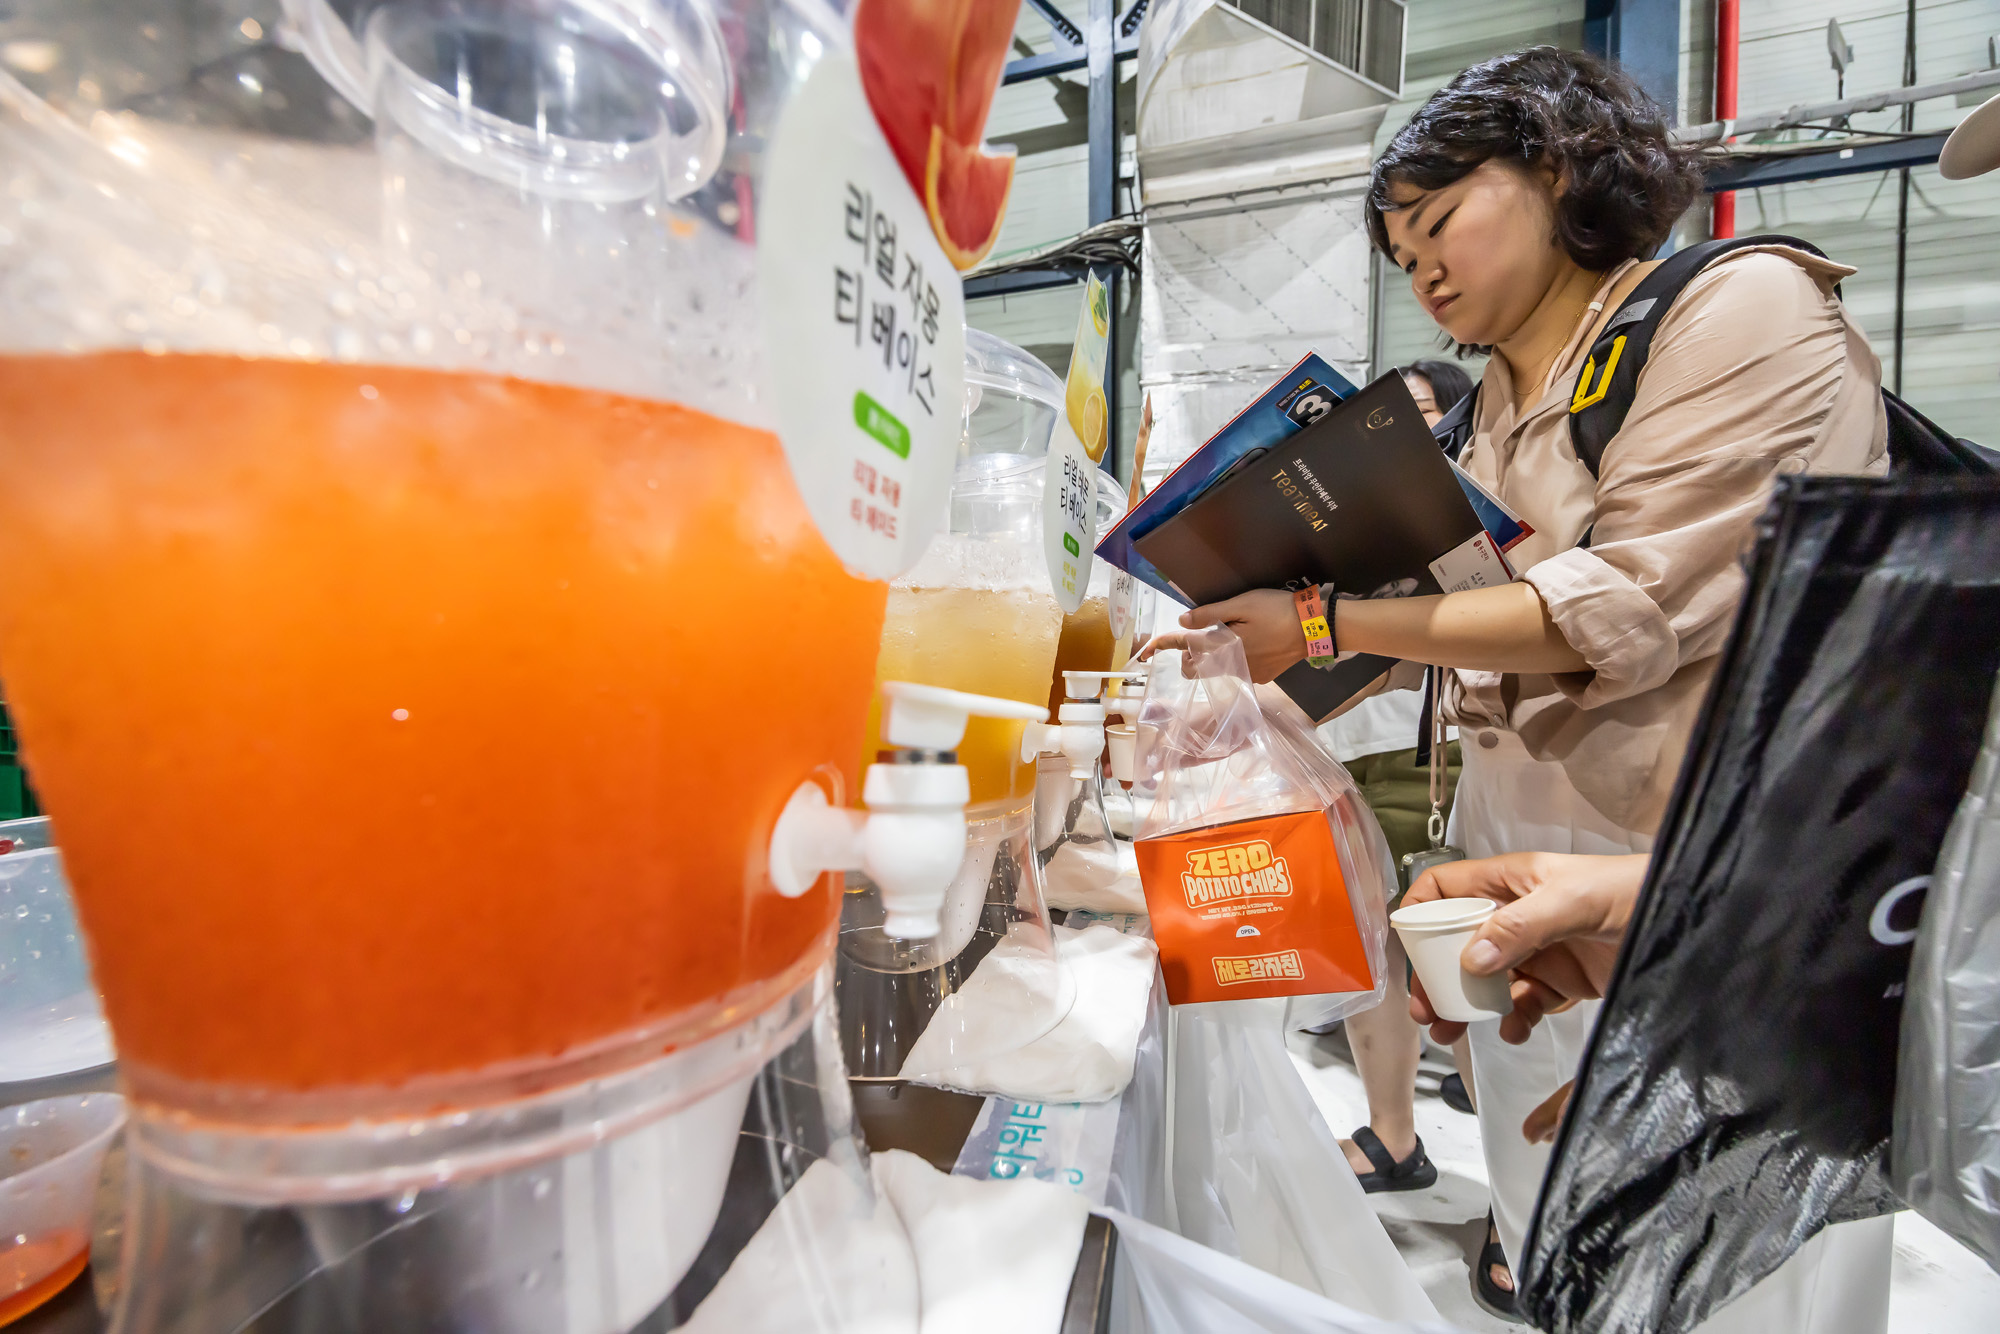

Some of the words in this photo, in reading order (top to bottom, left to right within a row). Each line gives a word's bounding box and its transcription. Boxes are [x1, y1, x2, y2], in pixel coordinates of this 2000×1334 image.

[844, 181, 896, 290] 리얼
[901, 252, 941, 345] 자몽
[834, 266, 863, 346] 티
[870, 301, 936, 416] 베이스
[1063, 454, 1078, 488] 리얼
[1078, 469, 1090, 504] 레몬
[1292, 458, 1314, 480] 프리미엄
[1308, 477, 1332, 503] 무인카페의
[1326, 500, 1339, 512] 시작
[1060, 485, 1068, 515] 티
[1069, 492, 1087, 535] 베이스
[1185, 872, 1241, 905] POTATO
[1241, 861, 1289, 895] CHIPS
[1190, 843, 1271, 877] ZERO
[1215, 953, 1301, 984] 제로감자칩
